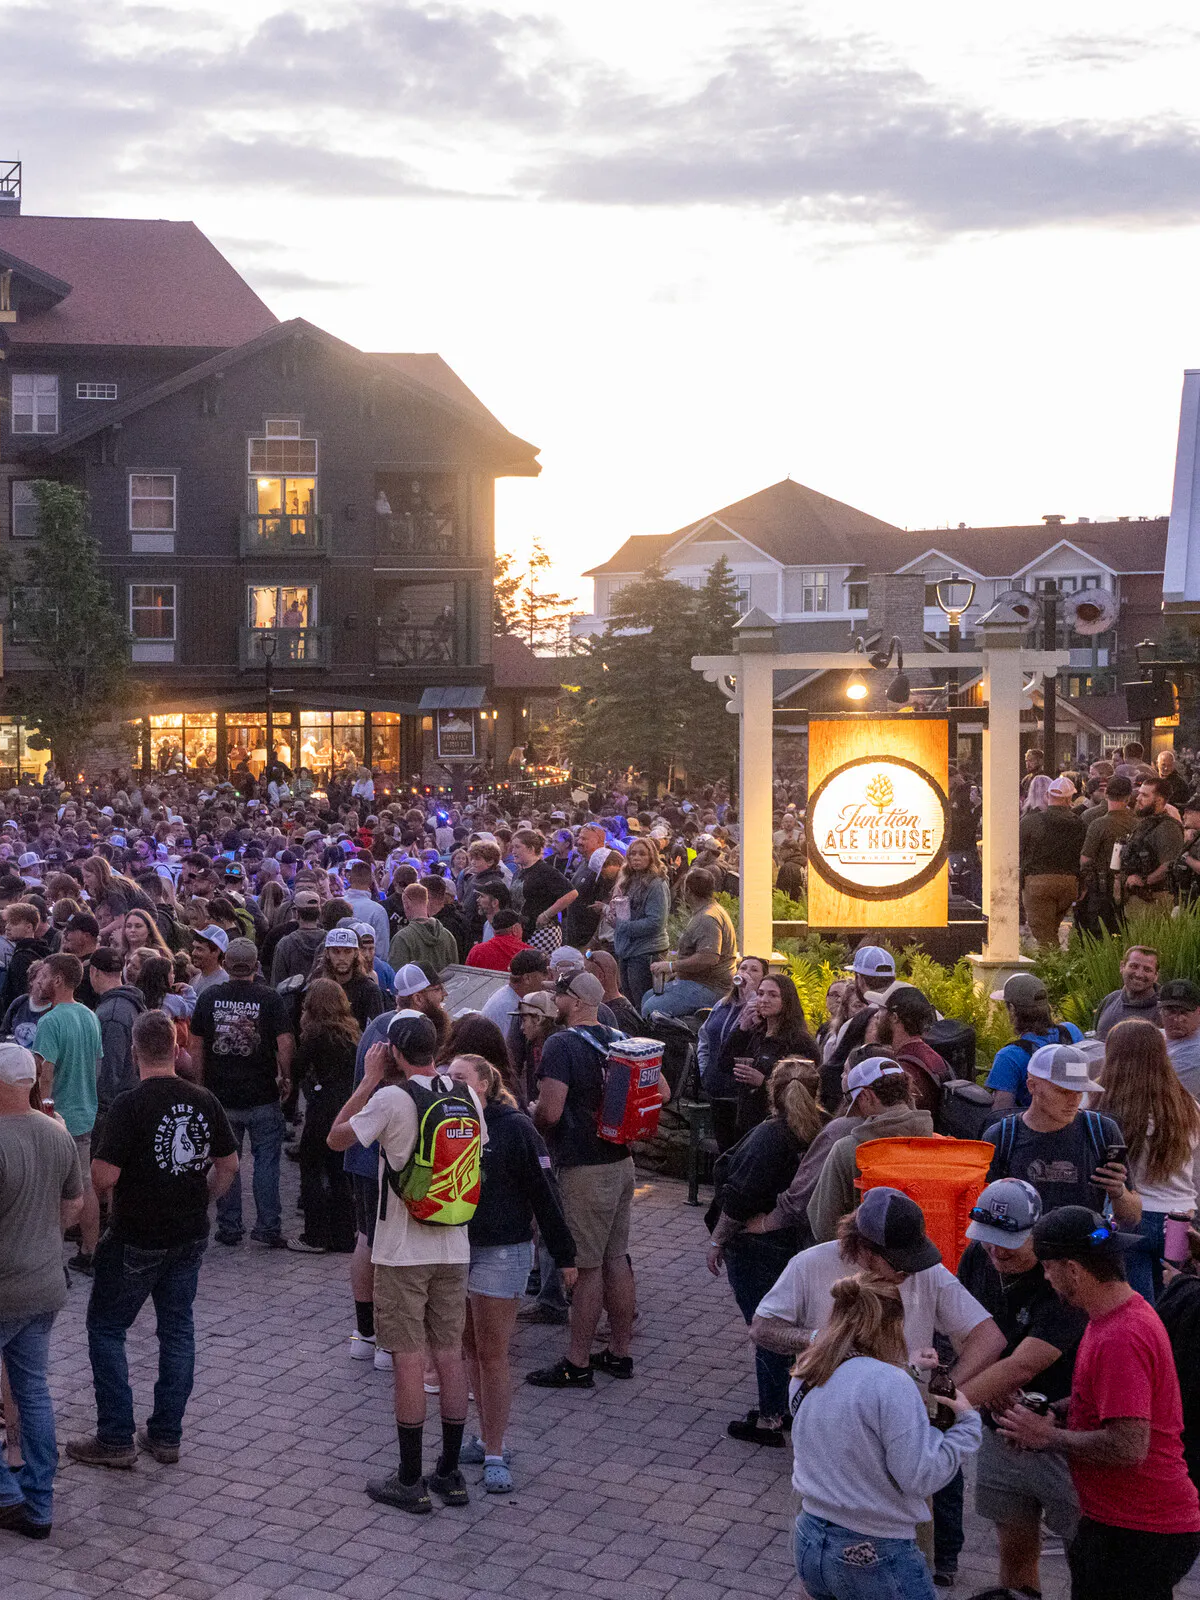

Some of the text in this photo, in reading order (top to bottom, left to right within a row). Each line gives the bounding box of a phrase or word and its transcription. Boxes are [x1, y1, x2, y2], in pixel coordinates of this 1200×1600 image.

[835, 804, 920, 833] Junction
[824, 829, 932, 849] ALE HOUSE
[214, 1000, 260, 1010] DUNGAN
[171, 1104, 194, 1115] THE
[197, 1112, 211, 1139] BAG
[154, 1115, 171, 1169] SECURE
